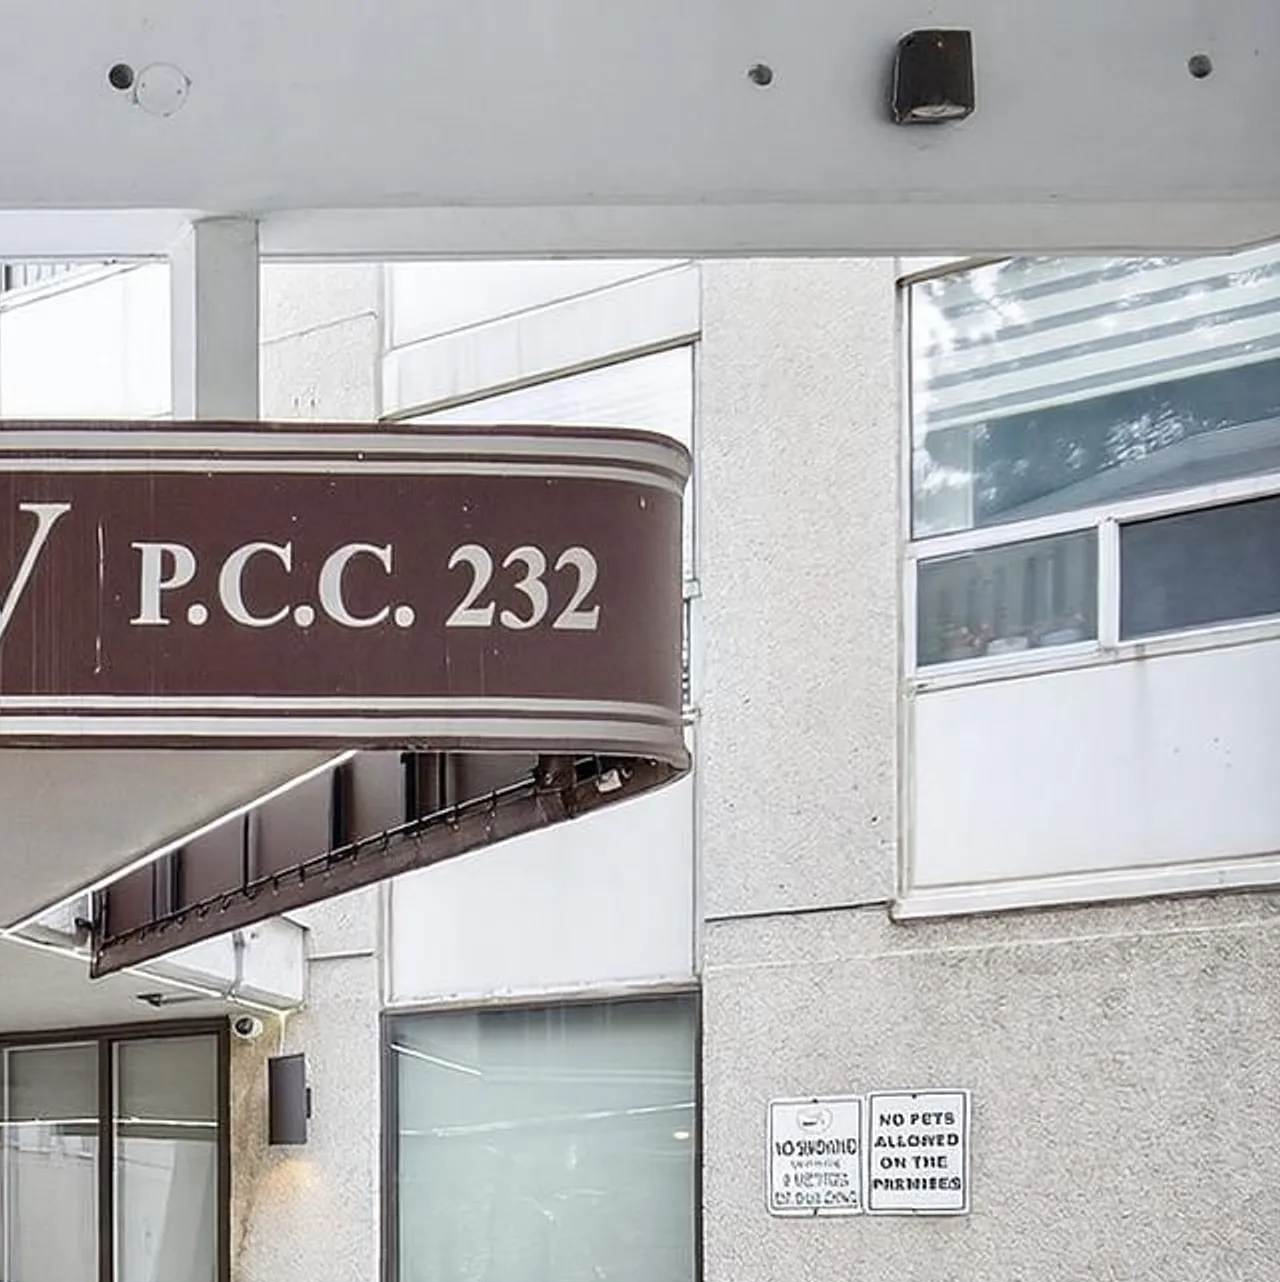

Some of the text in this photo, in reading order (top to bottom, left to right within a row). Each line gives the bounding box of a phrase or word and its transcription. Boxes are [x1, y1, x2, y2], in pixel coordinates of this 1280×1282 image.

[128, 541, 416, 629] P.C.C.
[444, 544, 602, 631] 232
[879, 1111, 956, 1127] NO PETS
[873, 1133, 960, 1149] ALLOWED
[879, 1155, 949, 1170] ON THE
